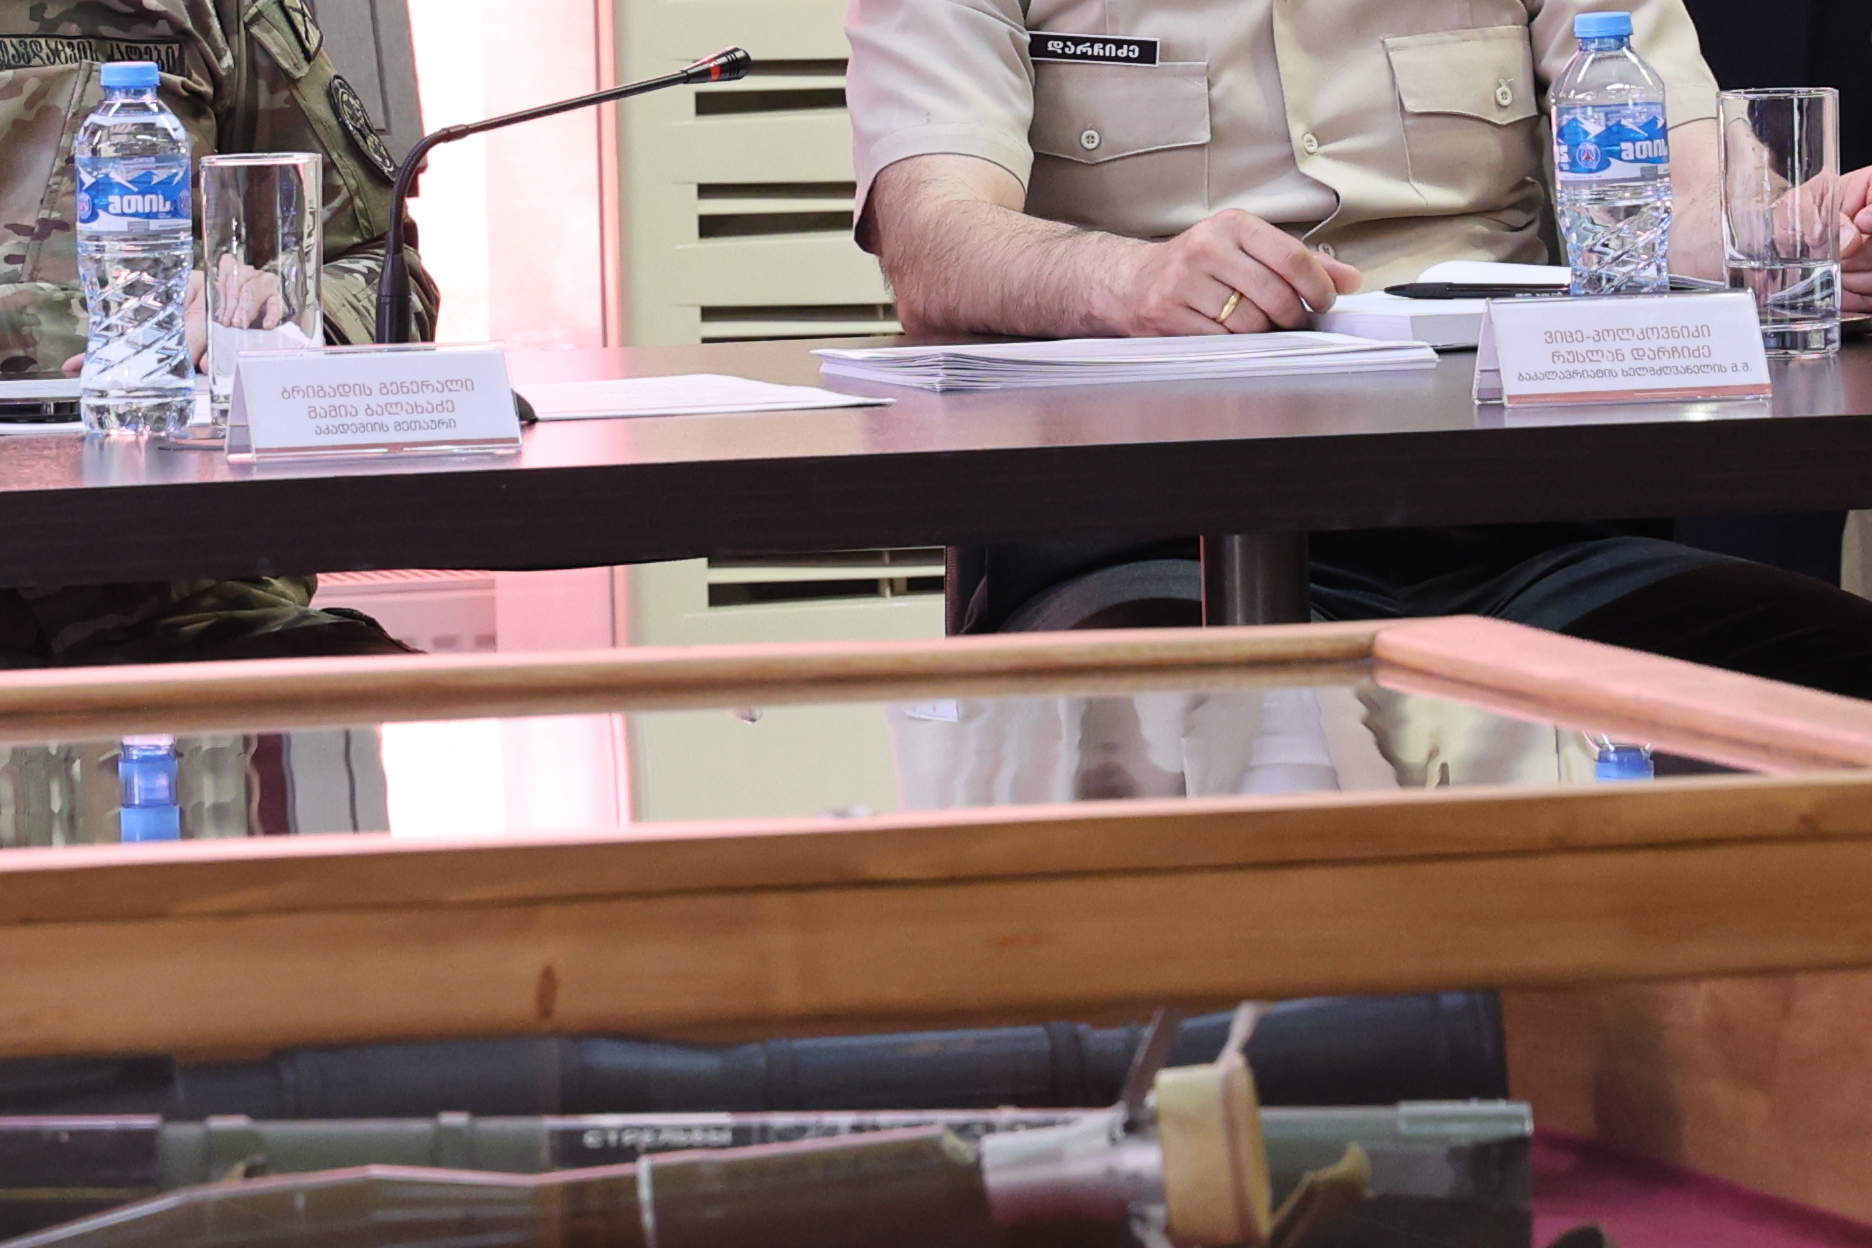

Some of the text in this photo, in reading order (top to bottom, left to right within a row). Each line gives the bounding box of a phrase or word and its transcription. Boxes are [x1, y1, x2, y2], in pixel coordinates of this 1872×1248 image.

[1047, 40, 1140, 58] დარჩიძე
[108, 194, 172, 214] მთის
[1544, 324, 1712, 345] ვიცე-პოლკოვნიკი
[1551, 344, 1712, 364] რუსლან დარჩიძე
[1517, 367, 1619, 382] ბაკალავრიატის
[1621, 363, 1728, 378] ხელმძღვანელის
[281, 378, 476, 400] ბრიგადის გენერალი
[307, 399, 456, 420] მამია ბალახაძე
[314, 418, 457, 436] აკადემიის მეთაური
